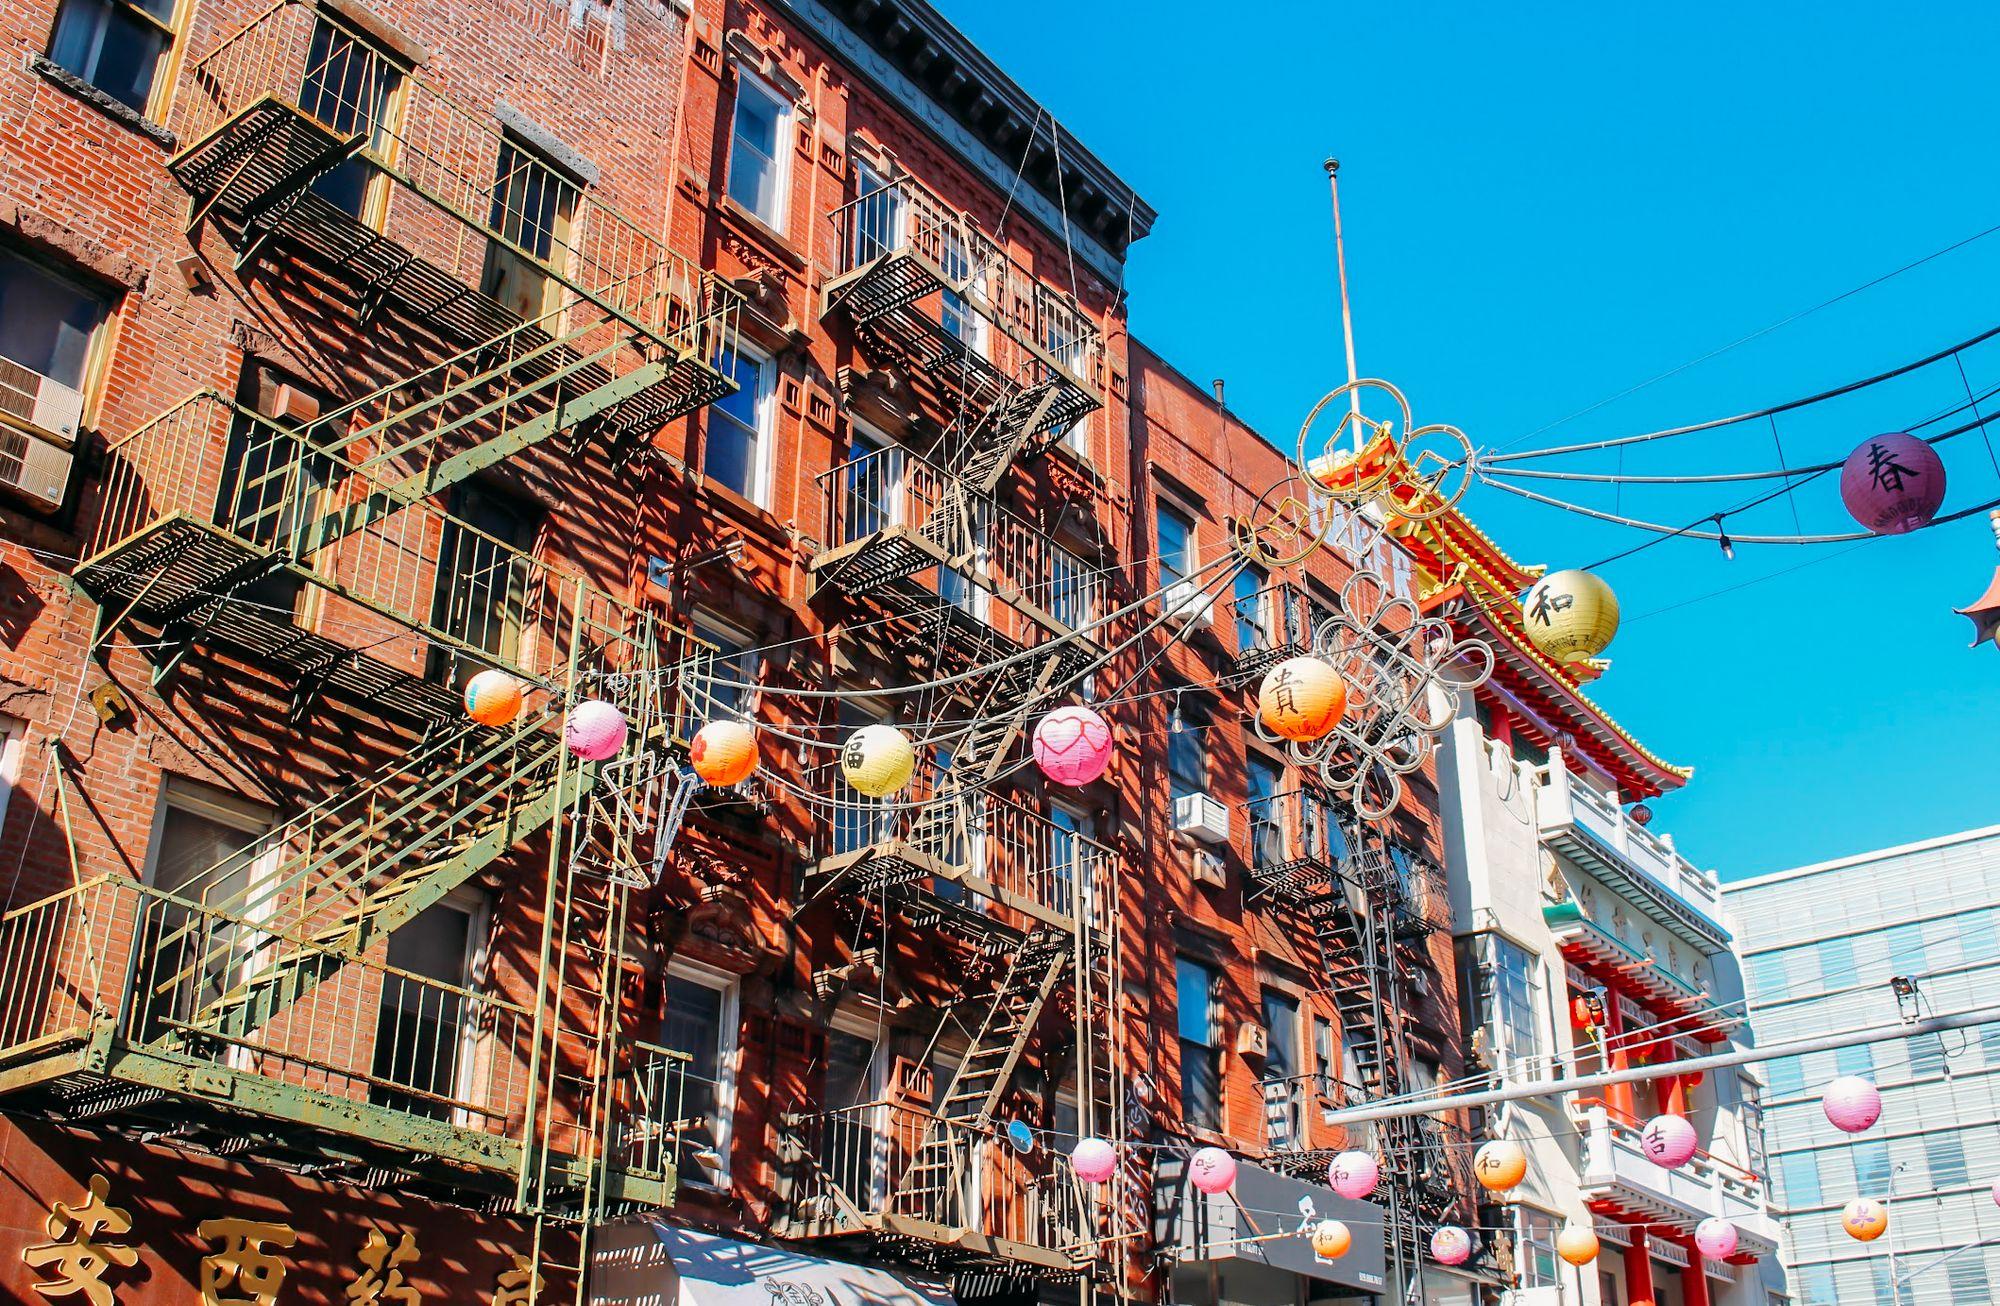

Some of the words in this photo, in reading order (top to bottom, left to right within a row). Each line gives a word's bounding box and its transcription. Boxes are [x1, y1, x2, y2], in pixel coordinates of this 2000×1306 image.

[1867, 443, 1921, 493] 春
[1530, 584, 1574, 627] 和
[1269, 668, 1304, 717] 貴
[1646, 1125, 1666, 1156] 吉
[1331, 1164, 1349, 1187] 和
[1477, 1151, 1501, 1176] 和
